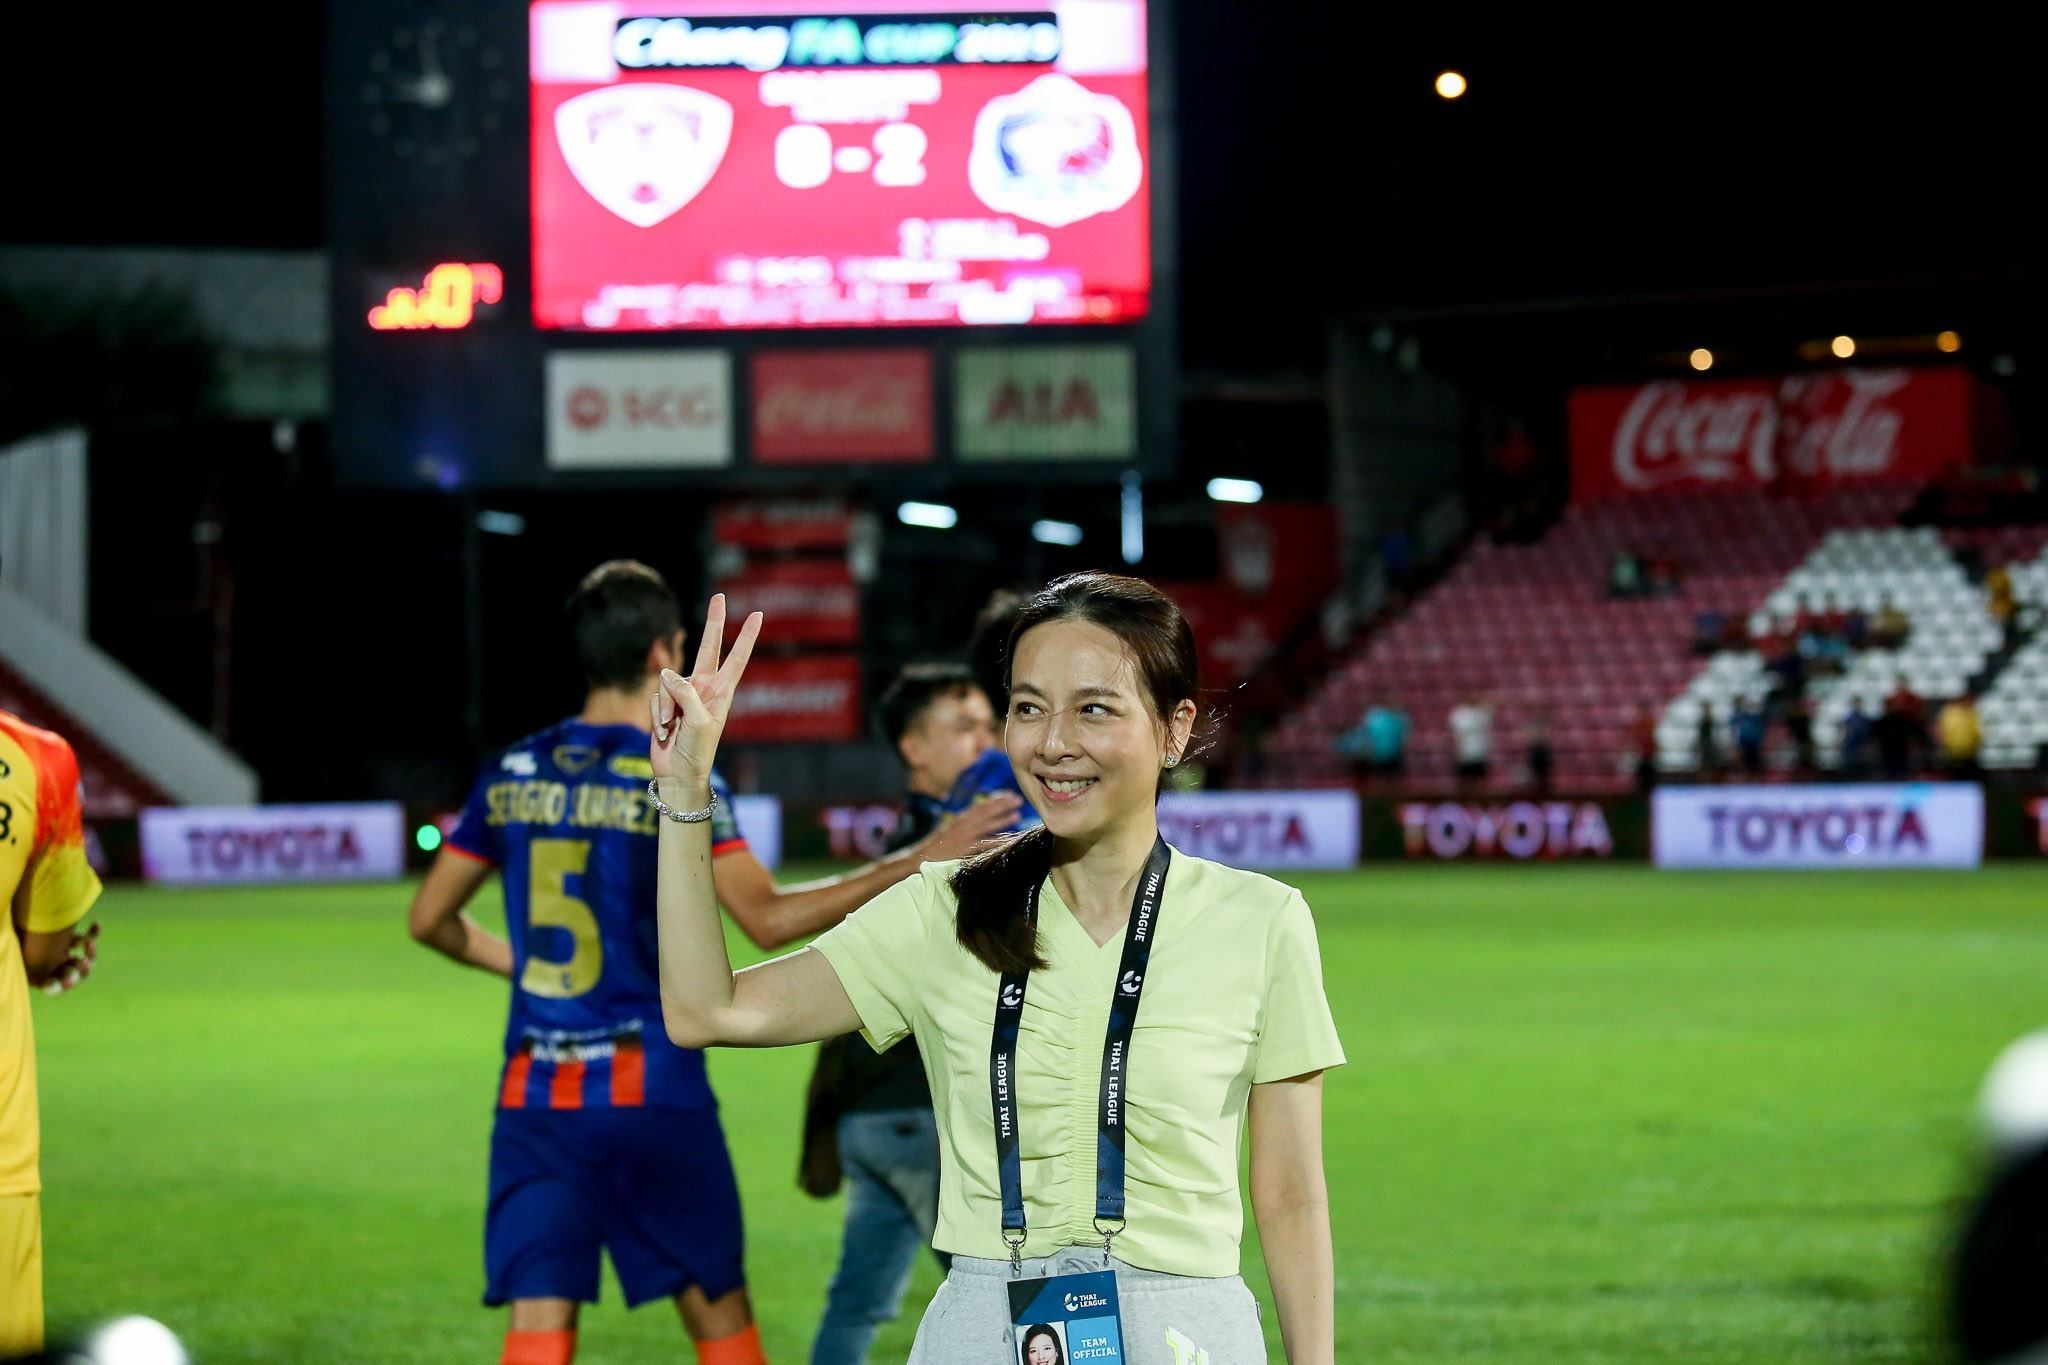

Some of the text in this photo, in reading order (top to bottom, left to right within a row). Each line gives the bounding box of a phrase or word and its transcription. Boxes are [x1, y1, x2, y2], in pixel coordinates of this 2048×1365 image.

[184, 825, 365, 872] TOYOTA
[1397, 802, 1614, 861] TOYOTA
[1707, 805, 1927, 854] TOYOTA
[520, 838, 604, 999] 5
[1134, 871, 1160, 942] THAI LEAGUE
[997, 1052, 1011, 1138] THAI LEAGUE
[1107, 1040, 1123, 1125] THAI LEAGUE
[1079, 1293, 1097, 1301] THAI
[1080, 1298, 1107, 1308] LEAGUE
[1073, 1347, 1117, 1360] OFFICIAL
[1081, 1337, 1107, 1348] TEAM
